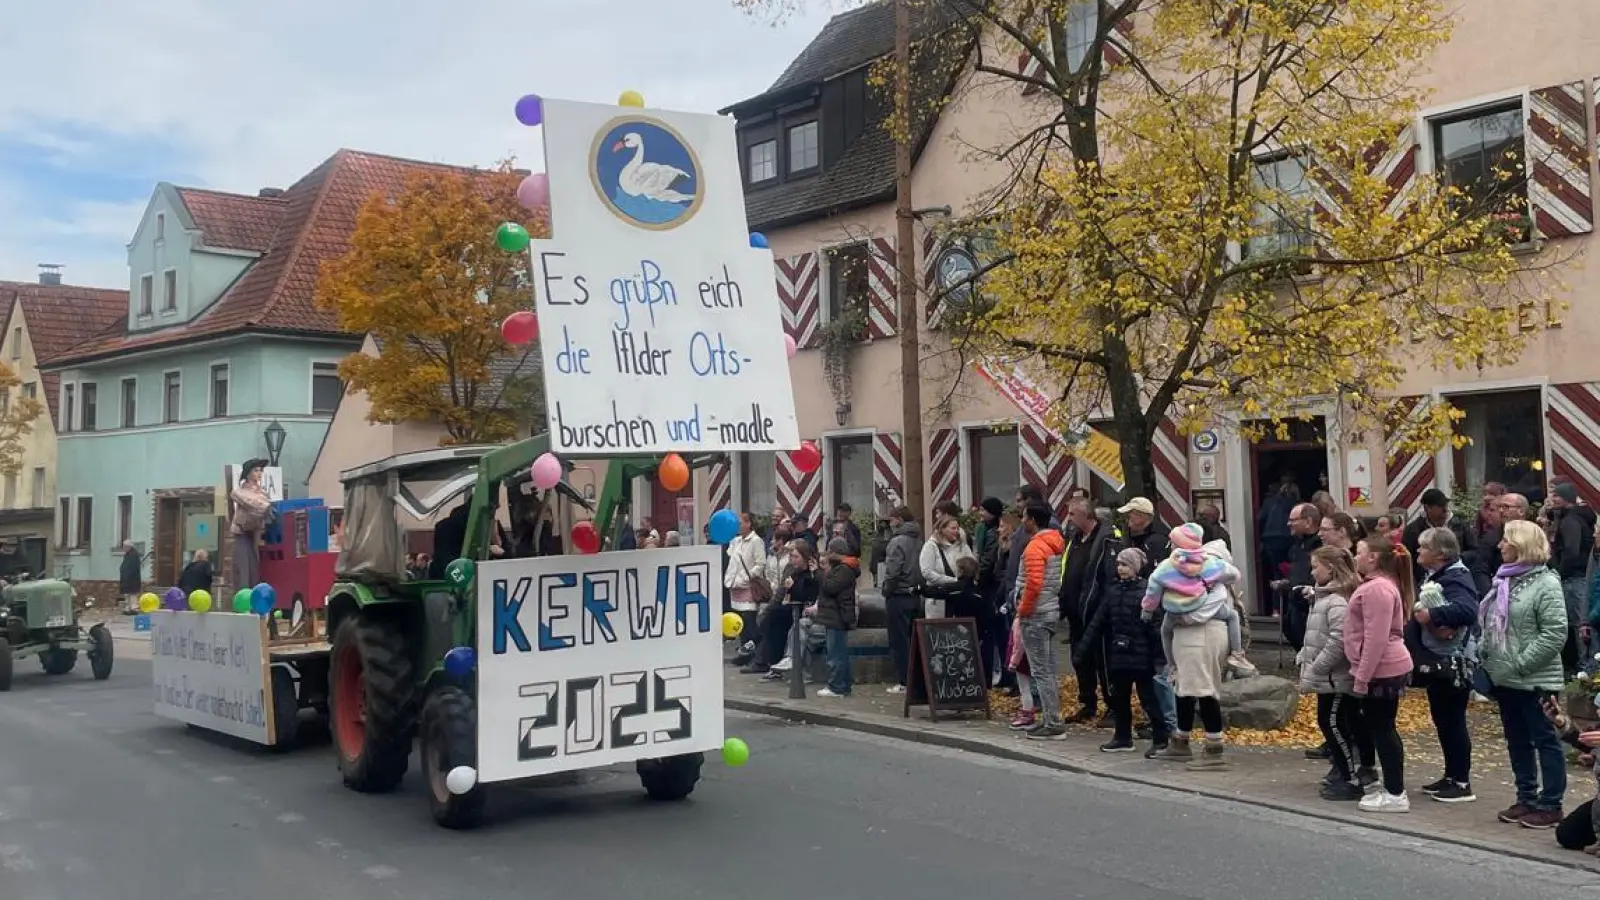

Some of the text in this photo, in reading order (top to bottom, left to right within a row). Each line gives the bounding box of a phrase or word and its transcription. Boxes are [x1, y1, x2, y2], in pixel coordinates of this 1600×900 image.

[541, 252, 589, 305] Es
[698, 264, 743, 308] eich
[556, 325, 591, 374] die
[690, 330, 751, 376] Orts-
[556, 399, 774, 447] burschen und -madle
[493, 561, 711, 654] KERWA
[517, 665, 692, 761] 2025
